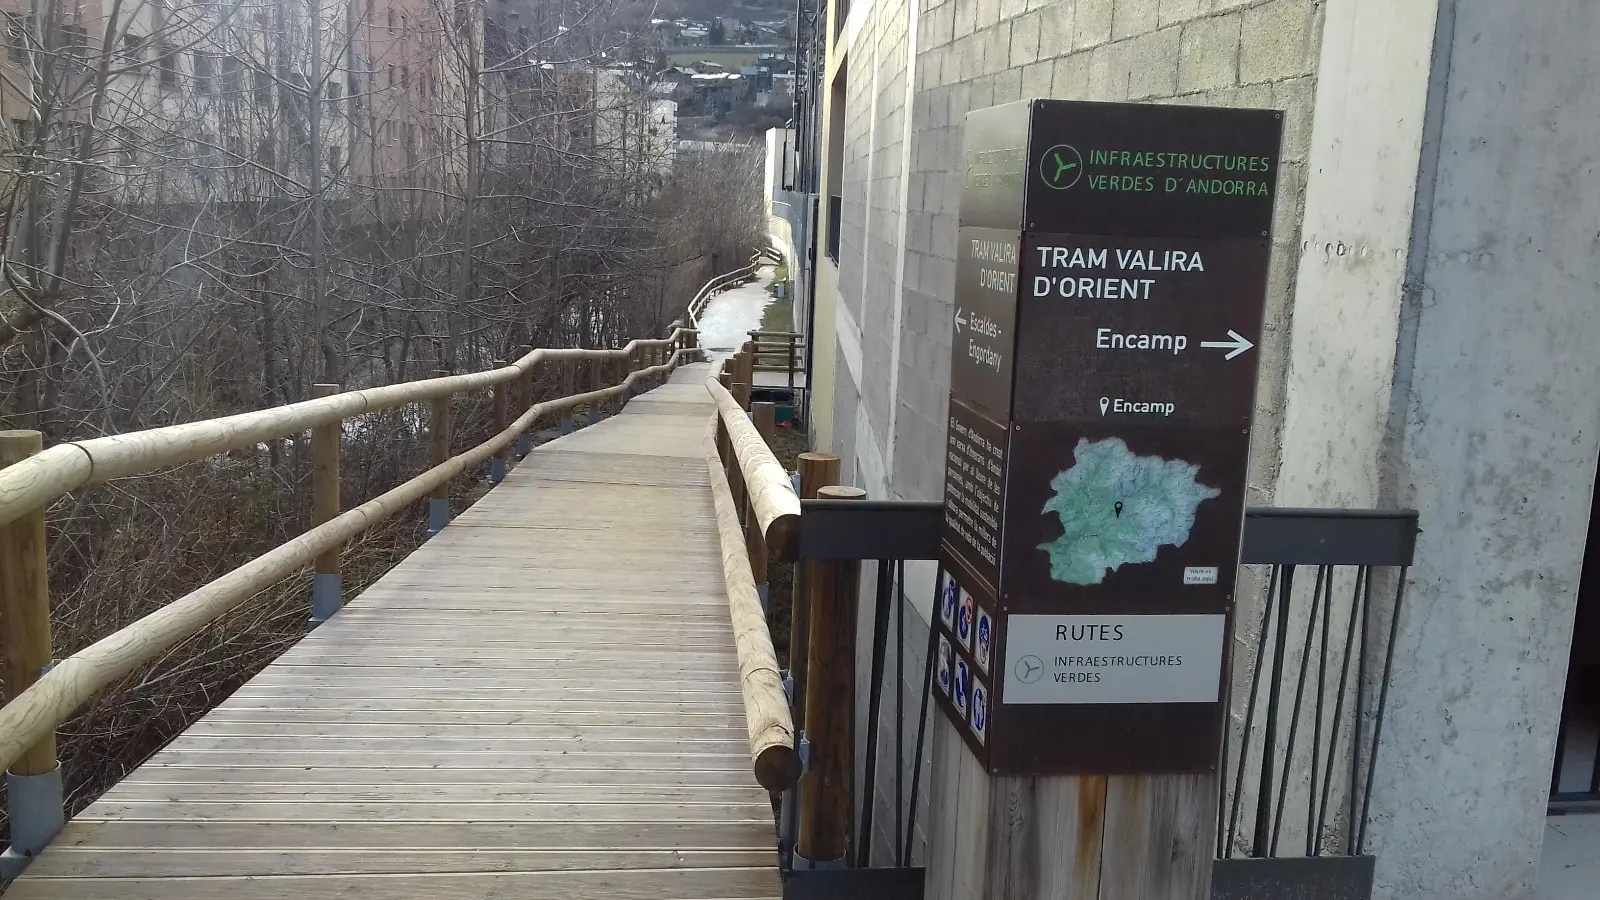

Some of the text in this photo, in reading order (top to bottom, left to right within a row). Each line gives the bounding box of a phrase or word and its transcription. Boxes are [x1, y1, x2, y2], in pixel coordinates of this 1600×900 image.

[1089, 150, 1270, 172] INFRAESTRUCTURES
[1088, 175, 1154, 191] VERDES
[972, 240, 1016, 264] TRAM VALIRA
[1037, 246, 1204, 272] TRAM VALIRA
[980, 268, 1015, 294] D'ORIENT
[1033, 276, 1156, 300] D'ORIENT
[1096, 328, 1187, 355] Encamp
[969, 338, 1002, 372] Engordany
[1113, 398, 1175, 416] Encamp
[1056, 624, 1124, 641] RUTES
[1054, 656, 1182, 667] INFRAESTRUCTURES
[1054, 672, 1100, 683] VERDES
